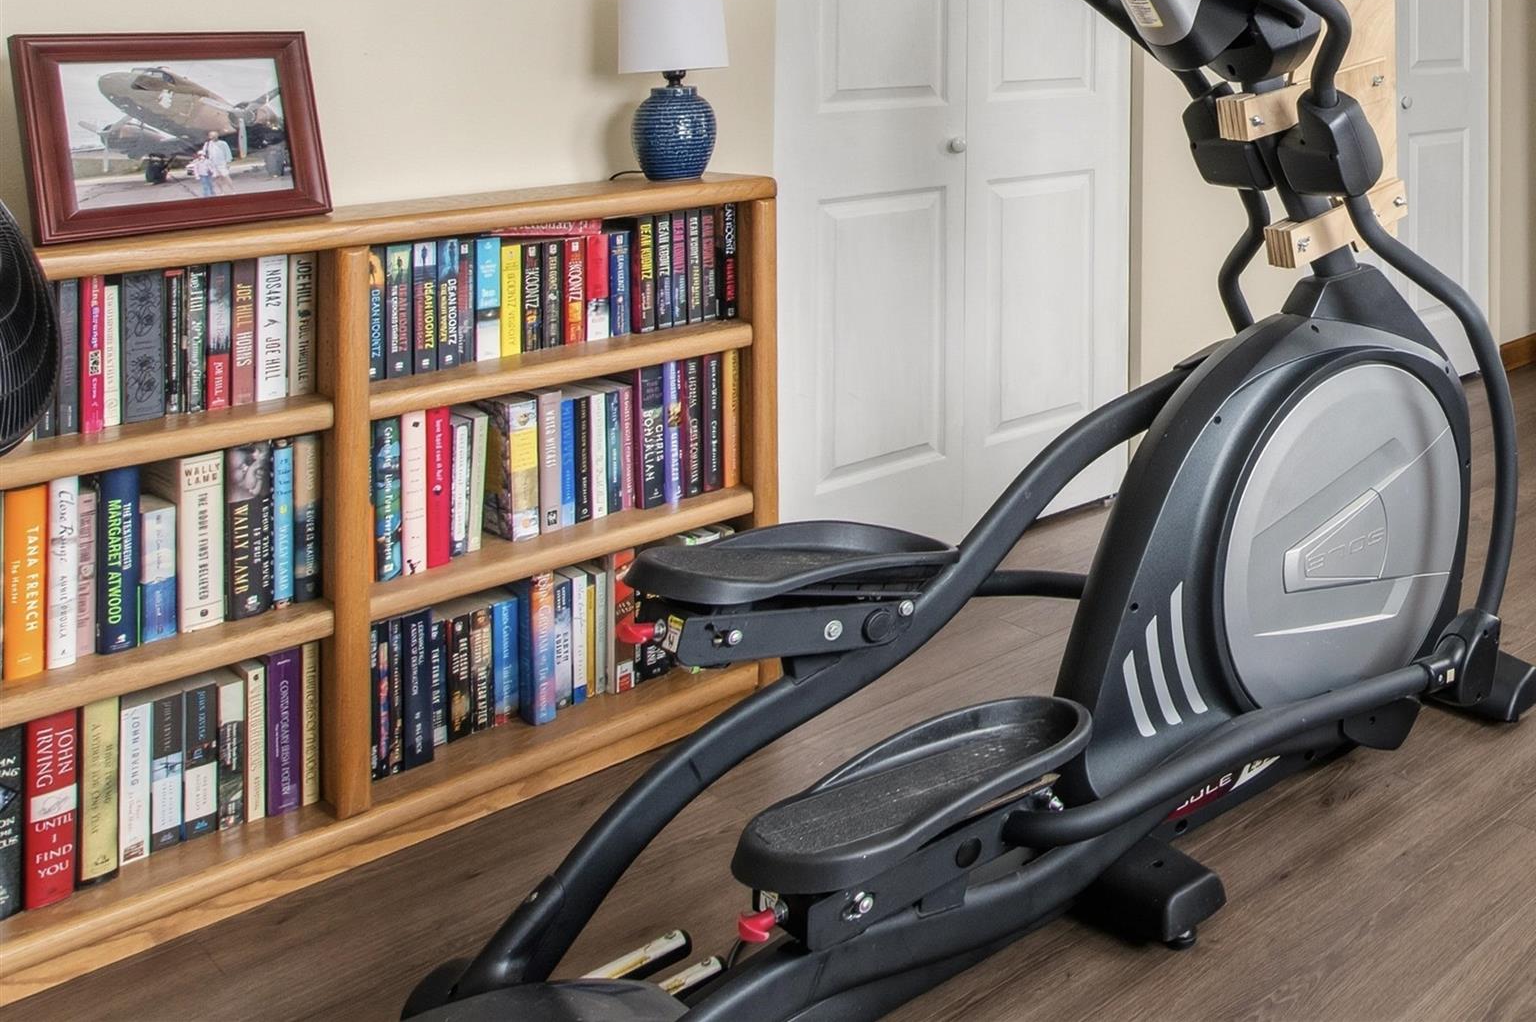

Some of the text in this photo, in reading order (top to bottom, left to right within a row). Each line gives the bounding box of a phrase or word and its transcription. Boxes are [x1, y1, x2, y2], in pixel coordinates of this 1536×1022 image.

[641, 223, 653, 280] DEAN KOONTZ
[659, 221, 671, 277] DEAN KOONTZ
[672, 219, 685, 275] DEAN KOONTZ
[689, 217, 699, 265] DEAN KOONTZ
[297, 260, 312, 307] JOE HILL
[526, 271, 540, 309] KOONTZ
[569, 265, 583, 303] KOONTZ
[236, 283, 252, 367] JOE HILL HORNS
[265, 269, 281, 381] NOS4A2 JOE HILL
[371, 289, 381, 358] DEAN KOONTZ
[399, 283, 408, 352] DEAN KOONTZ
[425, 282, 434, 349] DEAN KOONTZ
[448, 279, 457, 345] DEAN KOONTZ
[213, 361, 223, 395] JOE HILL
[644, 409, 657, 482] BOHJALIAN
[655, 424, 664, 462] CHRIS
[184, 462, 220, 479] WALLY
[187, 473, 218, 486] LAMB
[198, 492, 208, 508] THE
[198, 509, 208, 532] HOUR
[122, 503, 132, 570] THE TESTAMENTS
[198, 539, 208, 561] FIRST
[233, 504, 249, 595] WALLY LAMB
[253, 540, 261, 564] TRUE
[279, 525, 290, 592] WALLY LAMB
[383, 515, 394, 560] Everywhere
[1306, 528, 1386, 573] SOLE
[11, 560, 20, 605] The Hunter
[25, 525, 40, 633] TANA FRENCH
[108, 499, 122, 624] MARGARET ATWOOD
[198, 563, 208, 600] BELIEVED
[502, 604, 512, 660] JOHN GRISHAM
[431, 648, 440, 705] THE FINAL DAY
[130, 715, 140, 745] JOHN
[162, 700, 174, 752] JOHN IRVING
[197, 690, 207, 740] JOHN IRVING
[478, 700, 488, 725] AFTER
[36, 729, 53, 789] IRVING
[56, 729, 73, 775] JOHN
[279, 679, 292, 796] CONTEMPORARY IRISH POETRY
[103, 772, 113, 804] IRVING
[129, 747, 140, 787] IRVING
[35, 812, 73, 833] UNTIL
[35, 843, 73, 864] FIND
[38, 860, 70, 878] YOU
